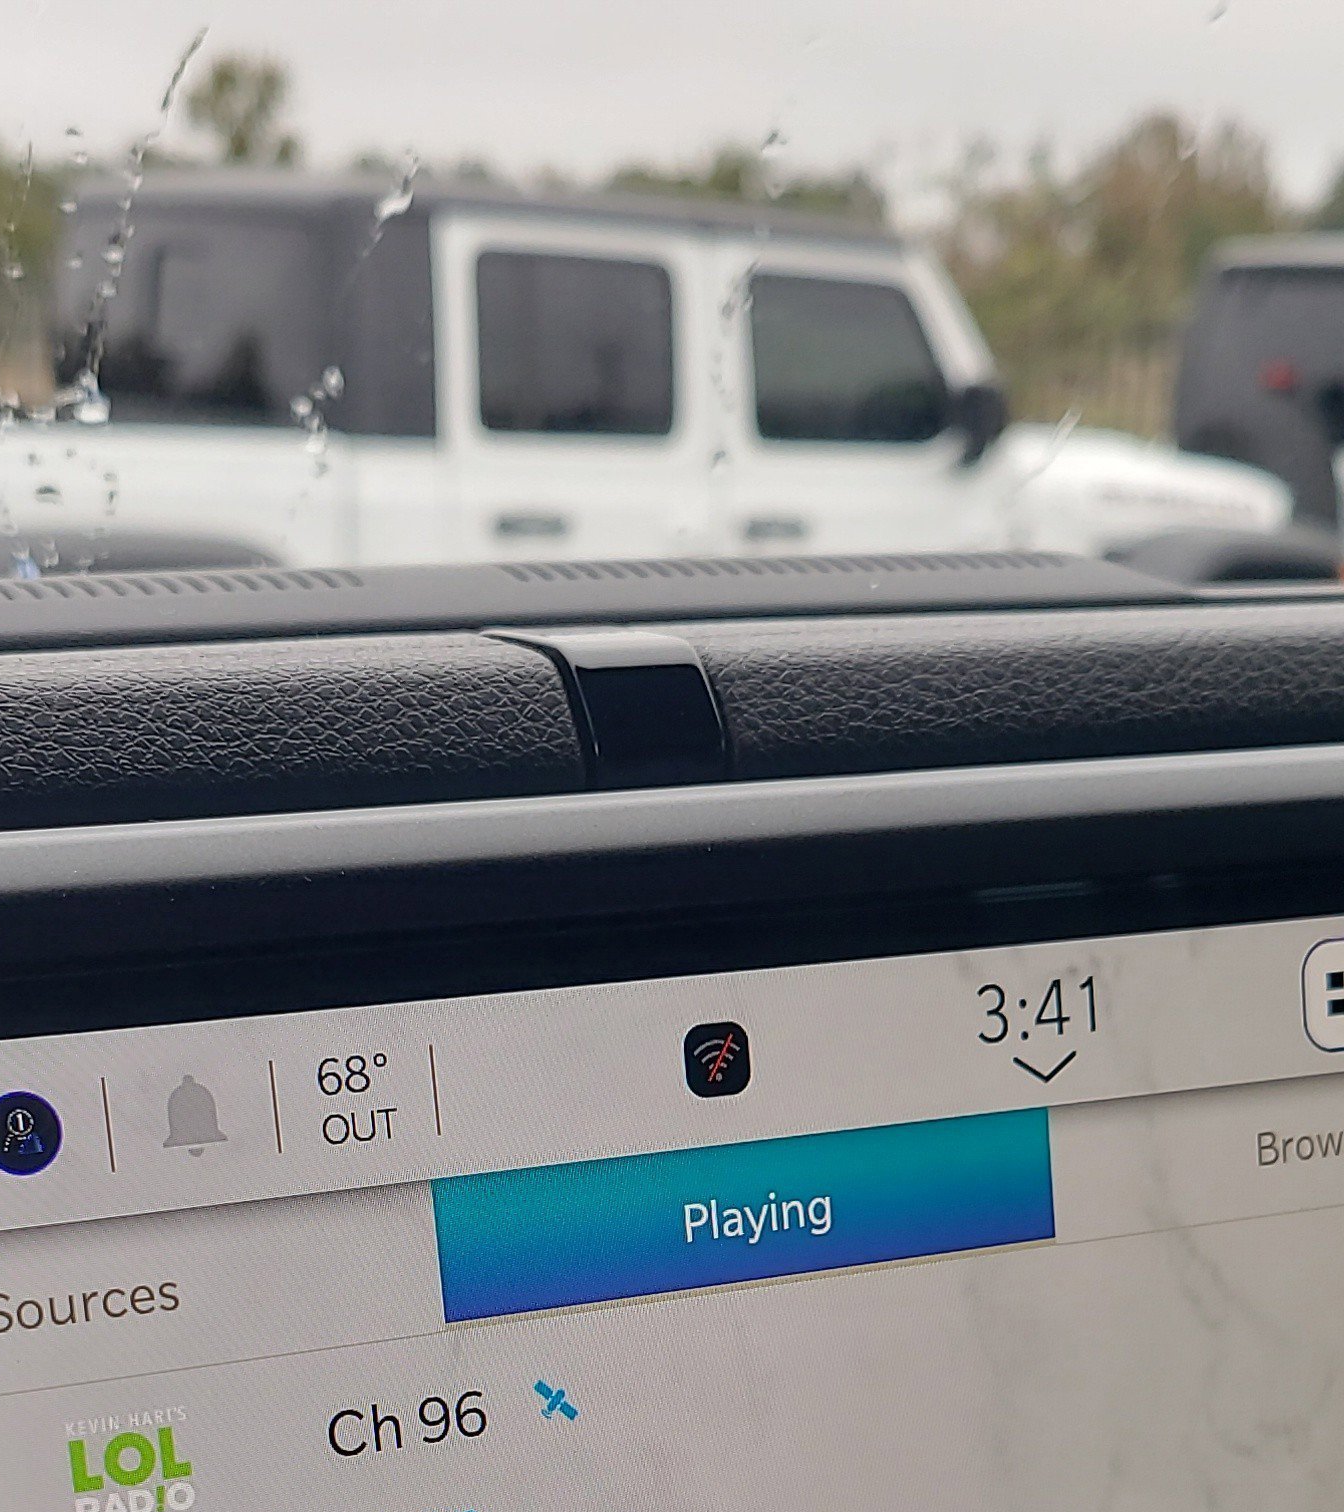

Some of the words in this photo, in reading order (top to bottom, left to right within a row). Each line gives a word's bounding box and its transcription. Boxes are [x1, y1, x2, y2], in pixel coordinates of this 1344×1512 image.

[975, 974, 1101, 1045] 3:41
[316, 1051, 389, 1097] 68°
[321, 1107, 398, 1146] OUT
[683, 1191, 834, 1245] Playing
[65, 1415, 120, 1437] KEVIN
[327, 1404, 403, 1457] Ch
[418, 1390, 488, 1444] 96
[68, 1426, 193, 1493] LOL
